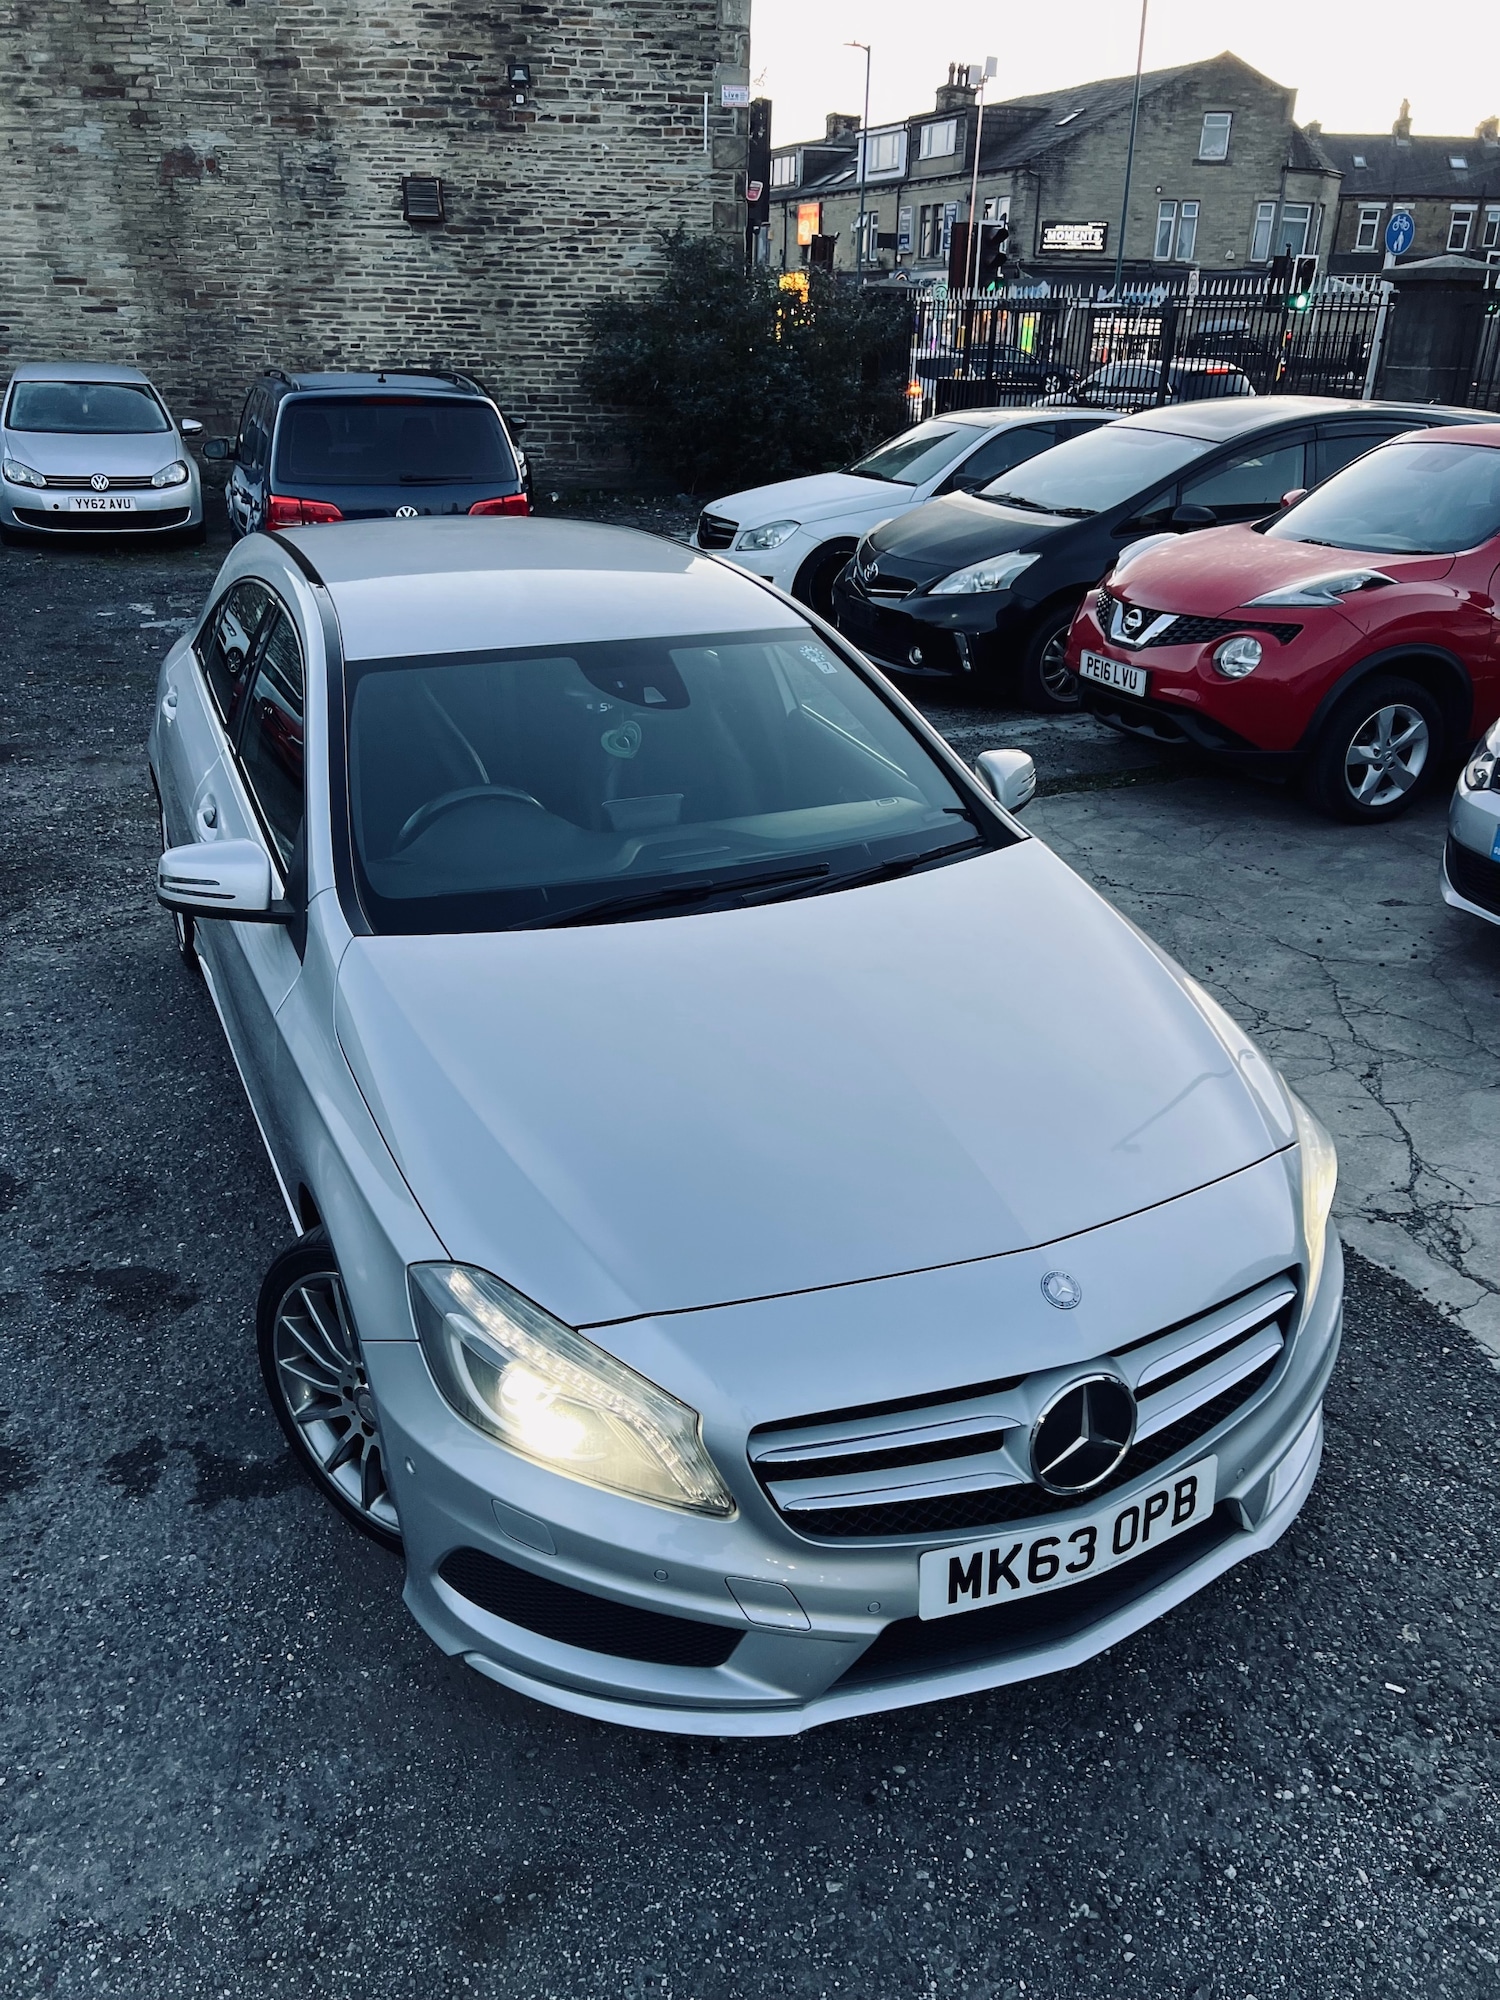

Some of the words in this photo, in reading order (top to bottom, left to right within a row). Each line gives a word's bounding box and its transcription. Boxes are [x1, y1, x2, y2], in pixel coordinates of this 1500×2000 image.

[1047, 230, 1101, 241] MOMENTS
[75, 498, 106, 509] YY62
[109, 498, 131, 509] AVU
[1086, 656, 1111, 681] PE16
[1113, 665, 1138, 690] LVU
[947, 1525, 1098, 1605] MK63
[1112, 1475, 1198, 1556] OPB
